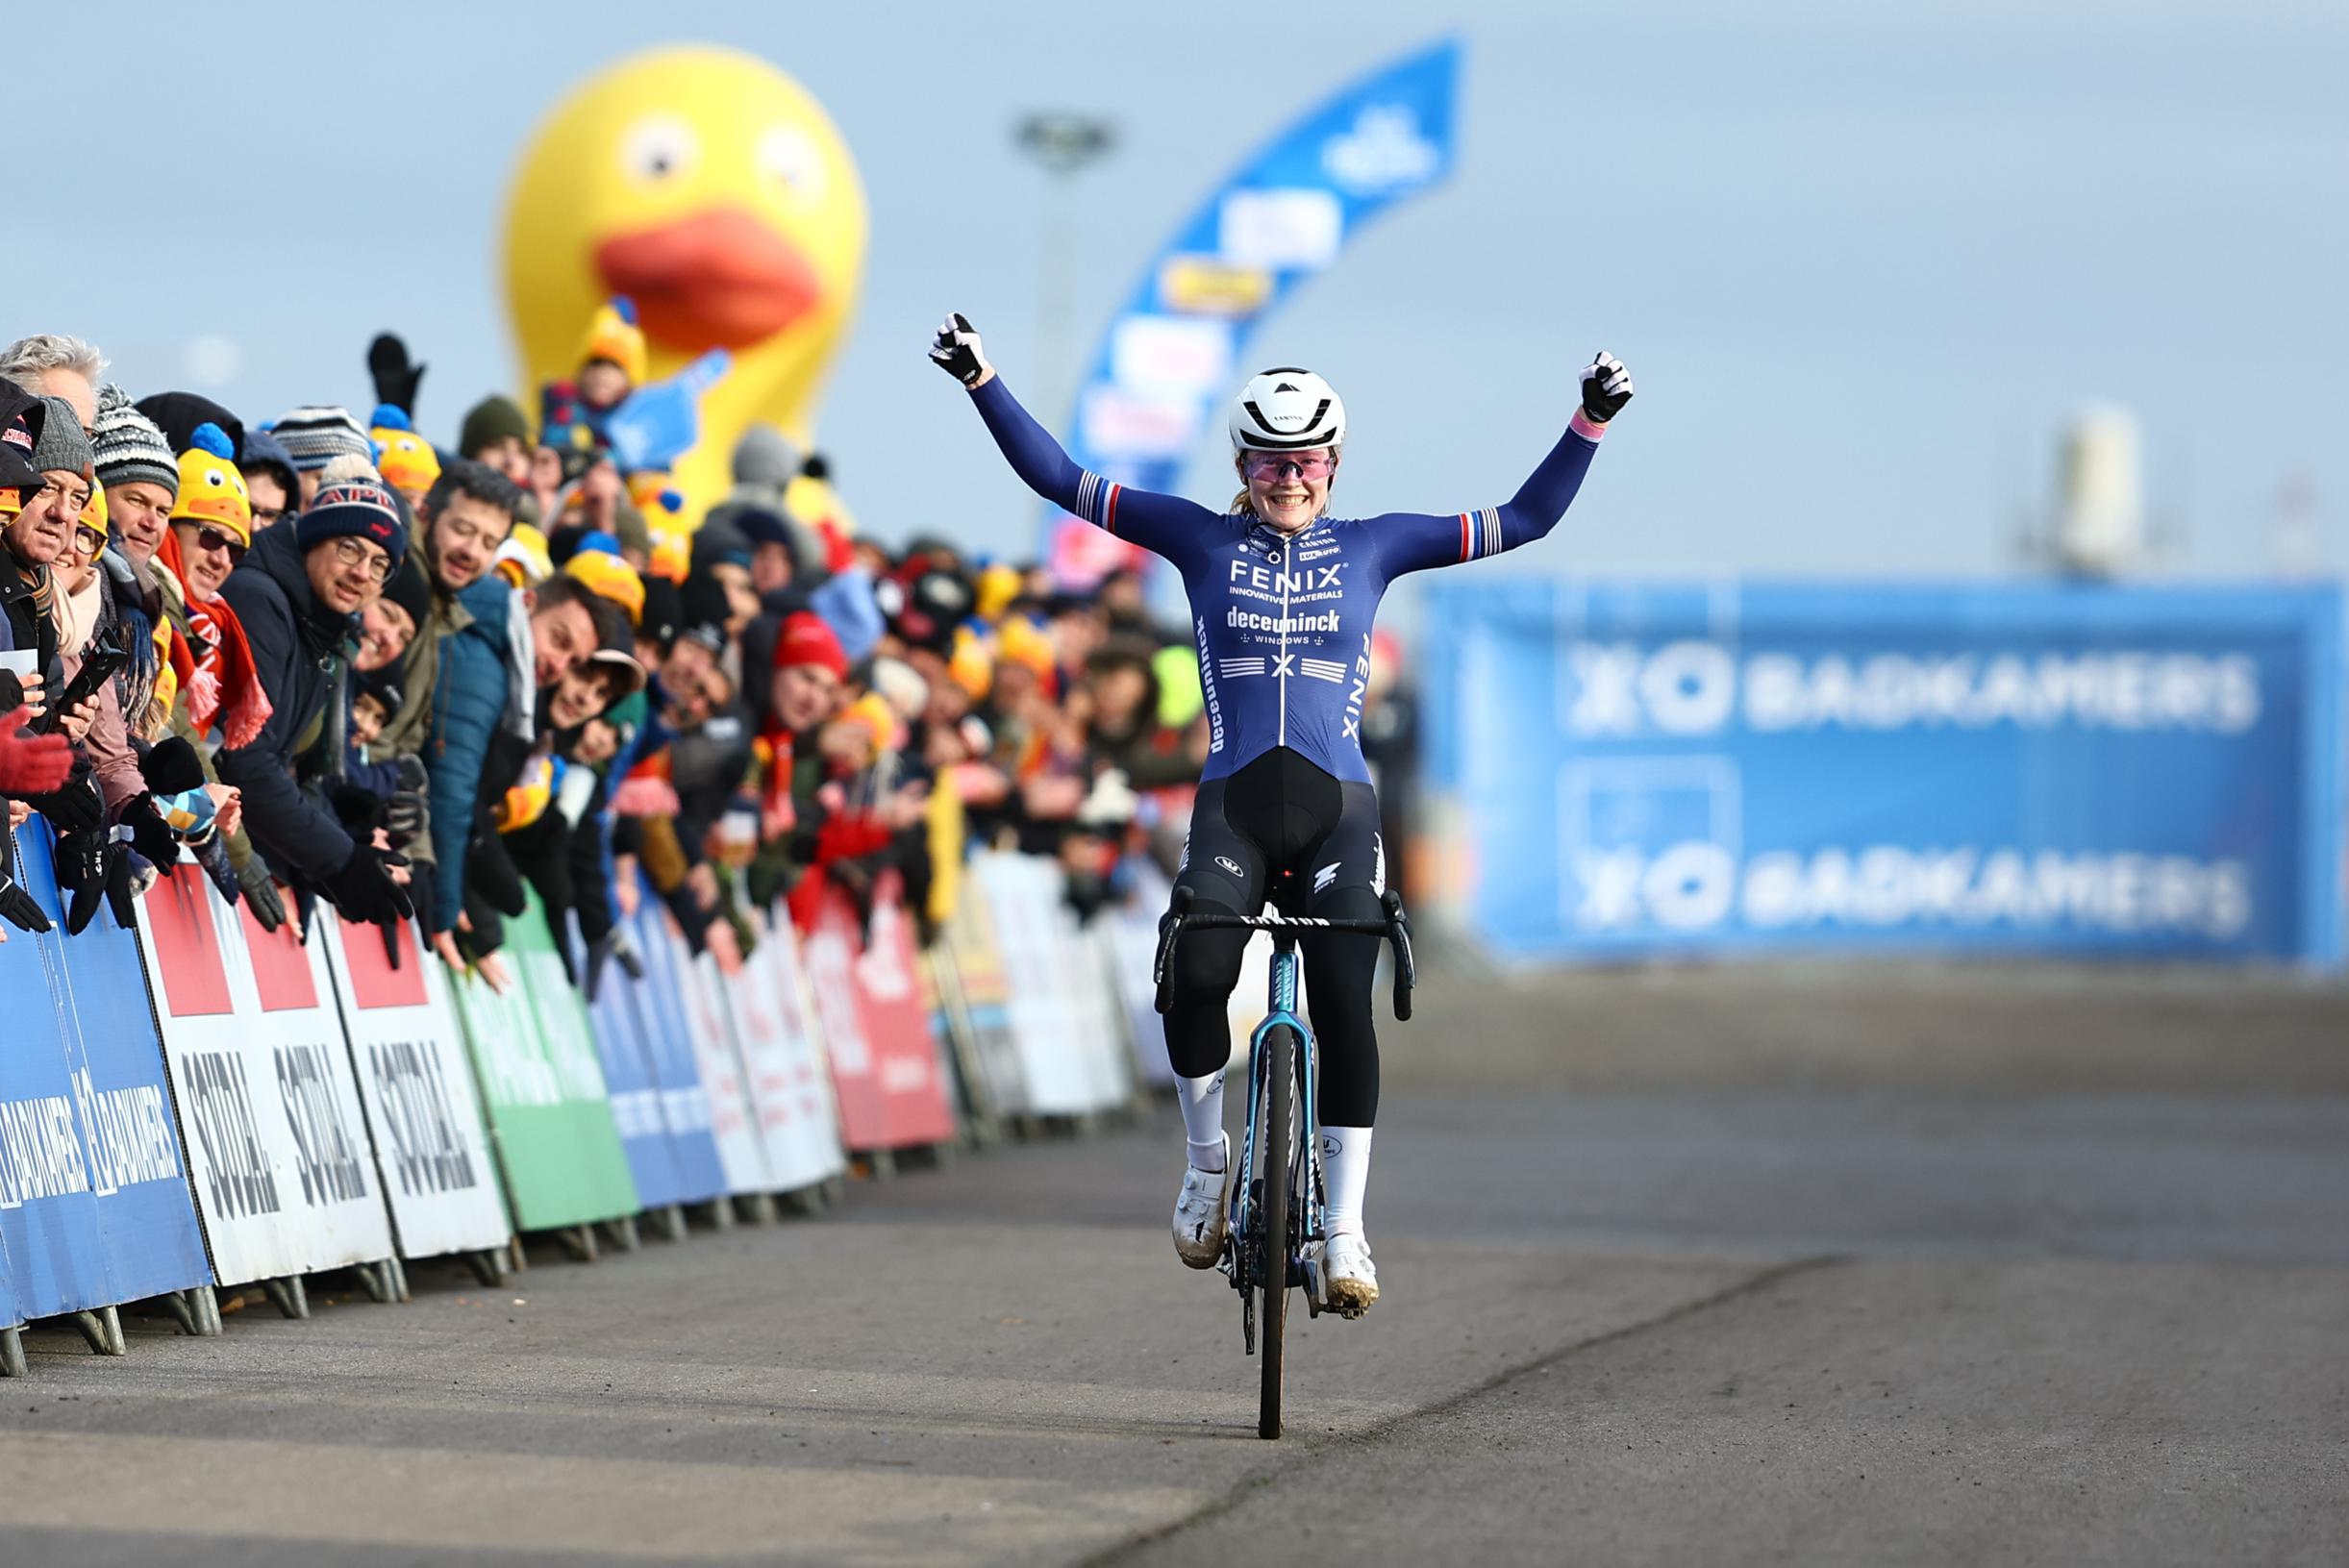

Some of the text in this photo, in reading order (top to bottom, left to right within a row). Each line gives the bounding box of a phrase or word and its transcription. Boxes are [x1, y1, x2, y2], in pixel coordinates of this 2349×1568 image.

[1227, 606, 1340, 634] deceuninck
[1229, 585, 1343, 605] INNOVATIVE MATERIALS
[1230, 560, 1343, 593] FENIX
[1255, 634, 1310, 646] WINDOWS
[1341, 631, 1370, 746] FENIX
[1741, 651, 2260, 736] BADKAMERS
[1741, 844, 2252, 936] BADKAMERS
[1, 1095, 89, 1201] BADKAMERS
[97, 1083, 178, 1186] BADKAMERS
[182, 1051, 281, 1221] SOUDAL
[273, 1044, 367, 1207] SOUDAL
